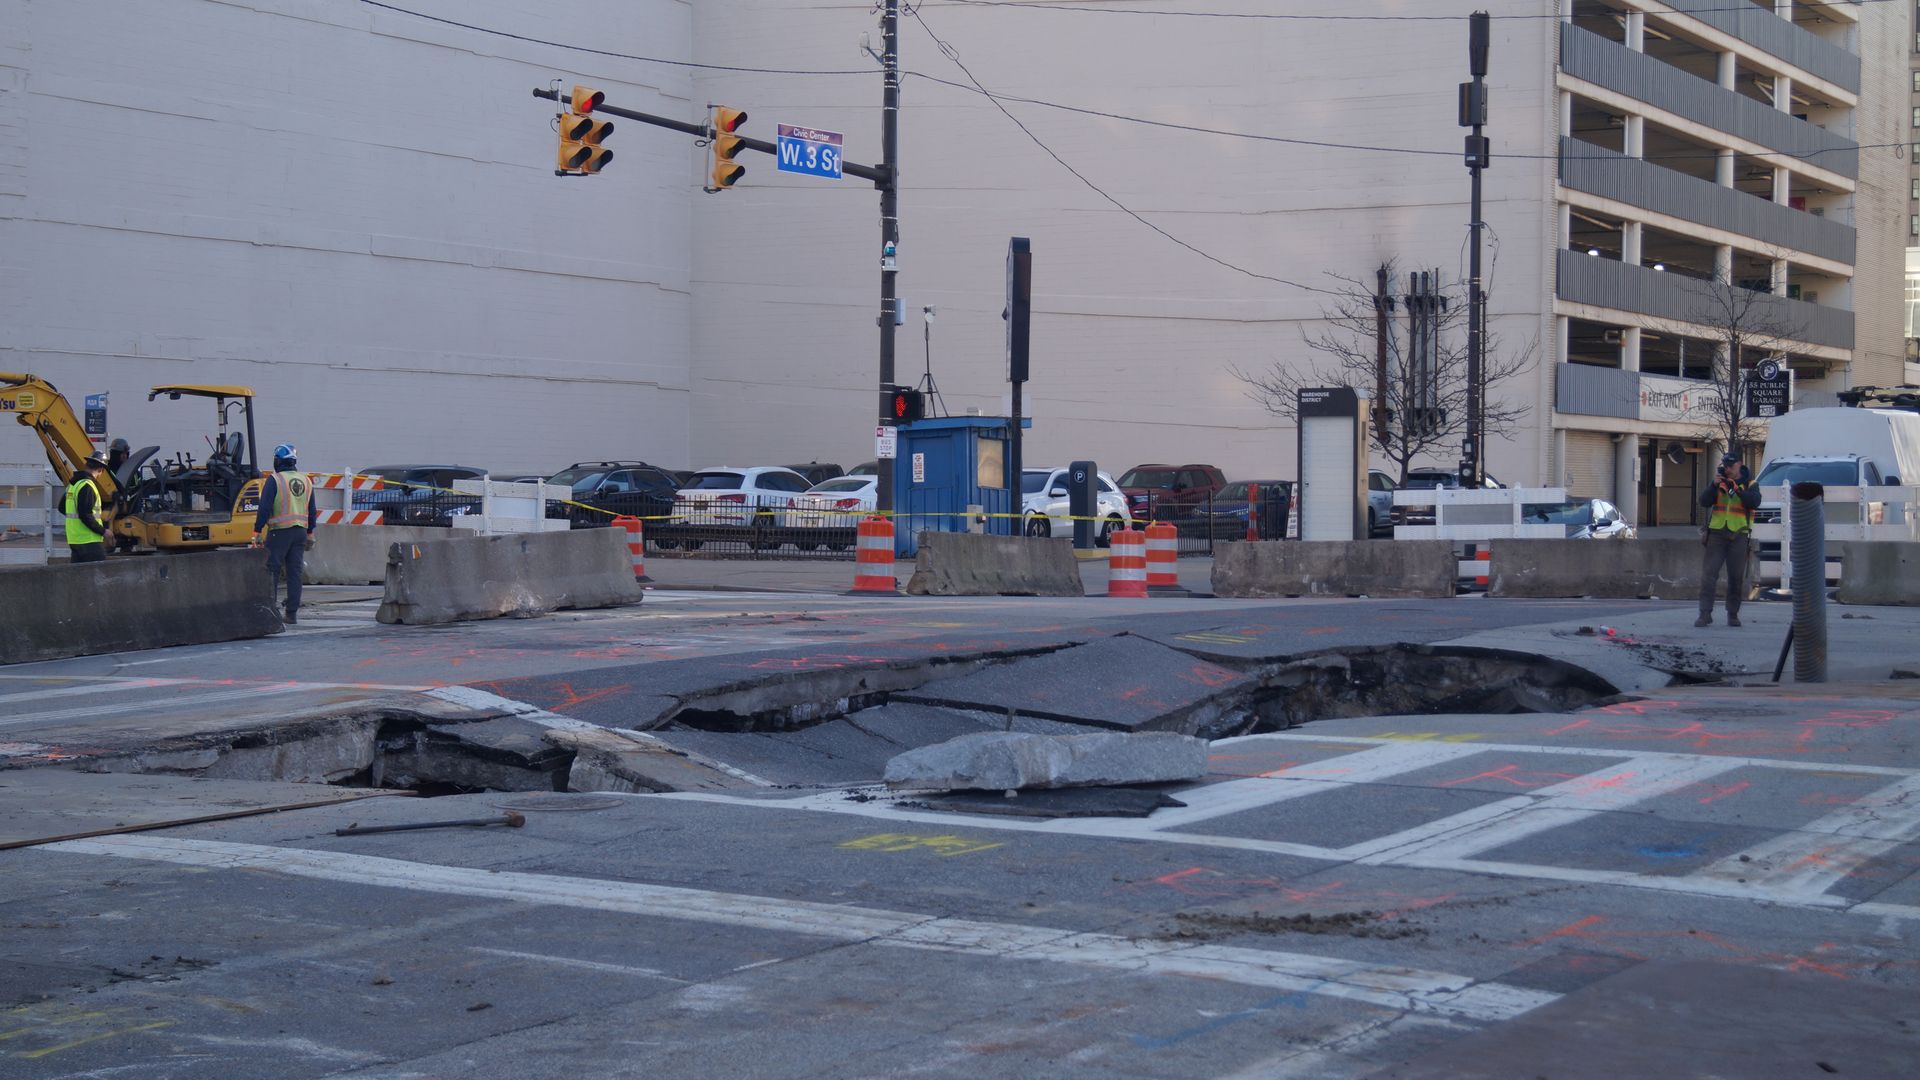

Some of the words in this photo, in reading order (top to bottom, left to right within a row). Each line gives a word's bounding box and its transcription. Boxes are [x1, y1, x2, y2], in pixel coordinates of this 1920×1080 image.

[793, 127, 808, 138] Civic
[810, 130, 829, 141] Center
[781, 142, 803, 167] W.
[806, 146, 817, 168] 3
[821, 148, 839, 173] St
[1648, 391, 1662, 407] EXIT
[1663, 393, 1681, 409] ONLY
[1752, 389, 1783, 397] SQUARE
